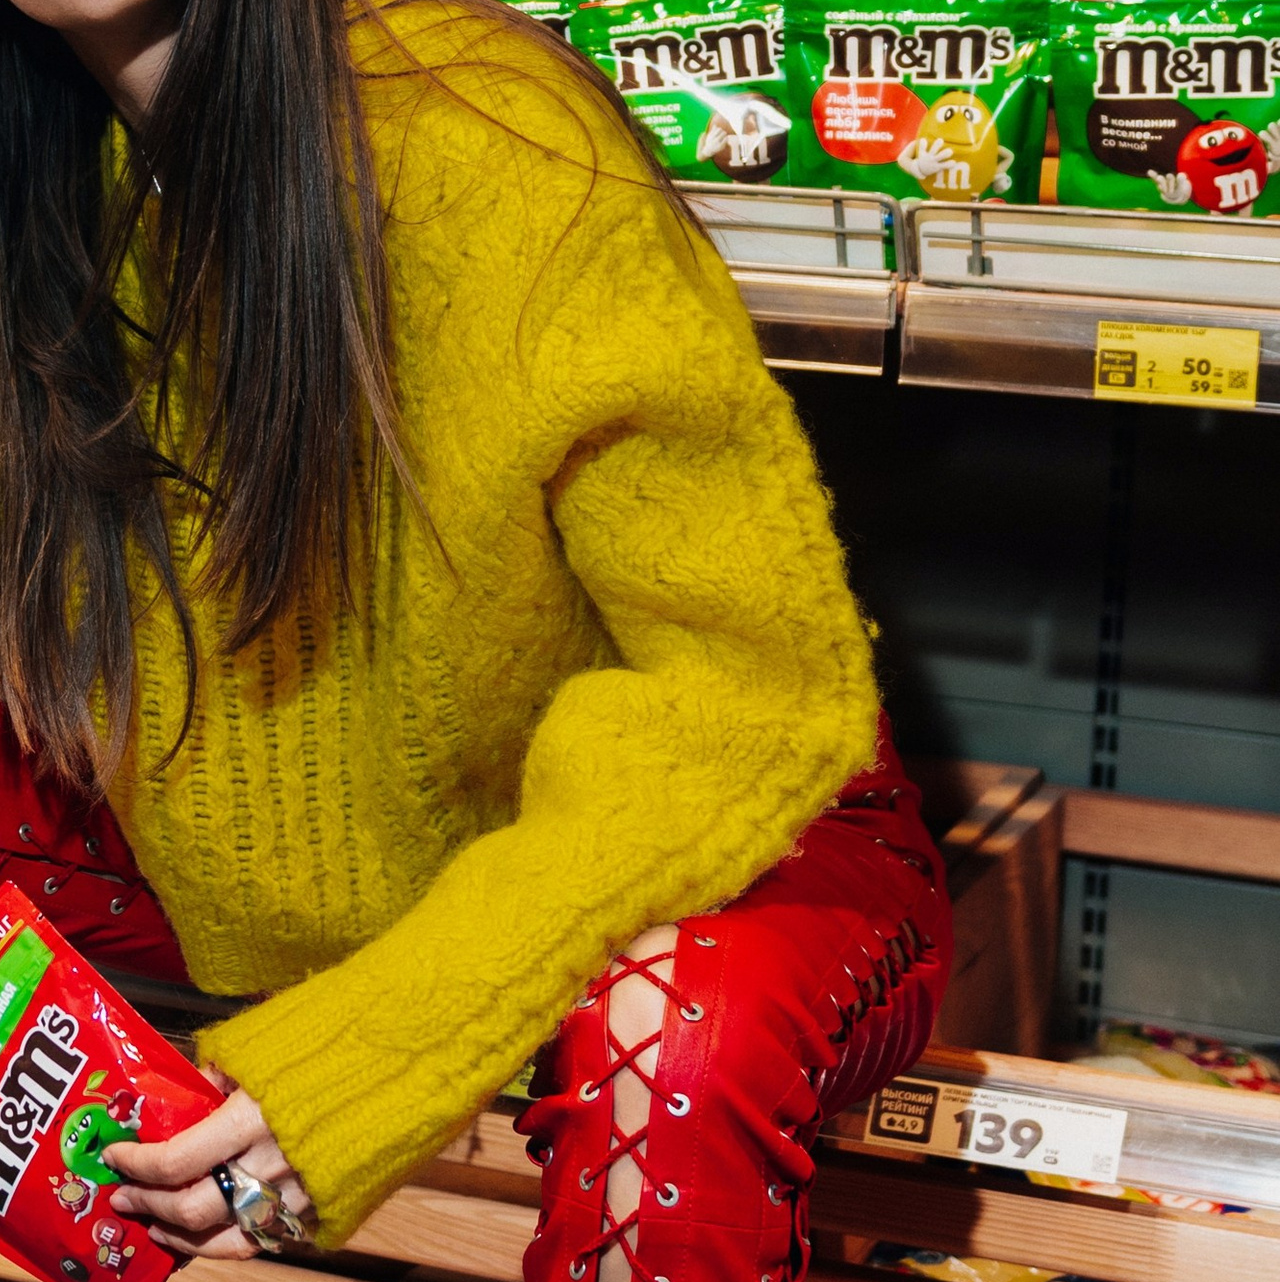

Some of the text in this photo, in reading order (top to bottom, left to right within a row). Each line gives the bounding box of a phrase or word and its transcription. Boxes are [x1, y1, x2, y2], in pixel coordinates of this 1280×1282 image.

[823, 23, 1015, 85] m&m's
[1100, 115, 1177, 128] В компании
[1102, 139, 1148, 151] со мной
[1213, 168, 1261, 208] m
[1182, 357, 1212, 376] 50
[1190, 379, 1211, 393] 59
[881, 1087, 935, 1105] ВЫСОКИЙ
[880, 1100, 929, 1116] РЕЙТИНГ
[897, 1118, 919, 1132] 4,9
[953, 1109, 1044, 1160] 139
